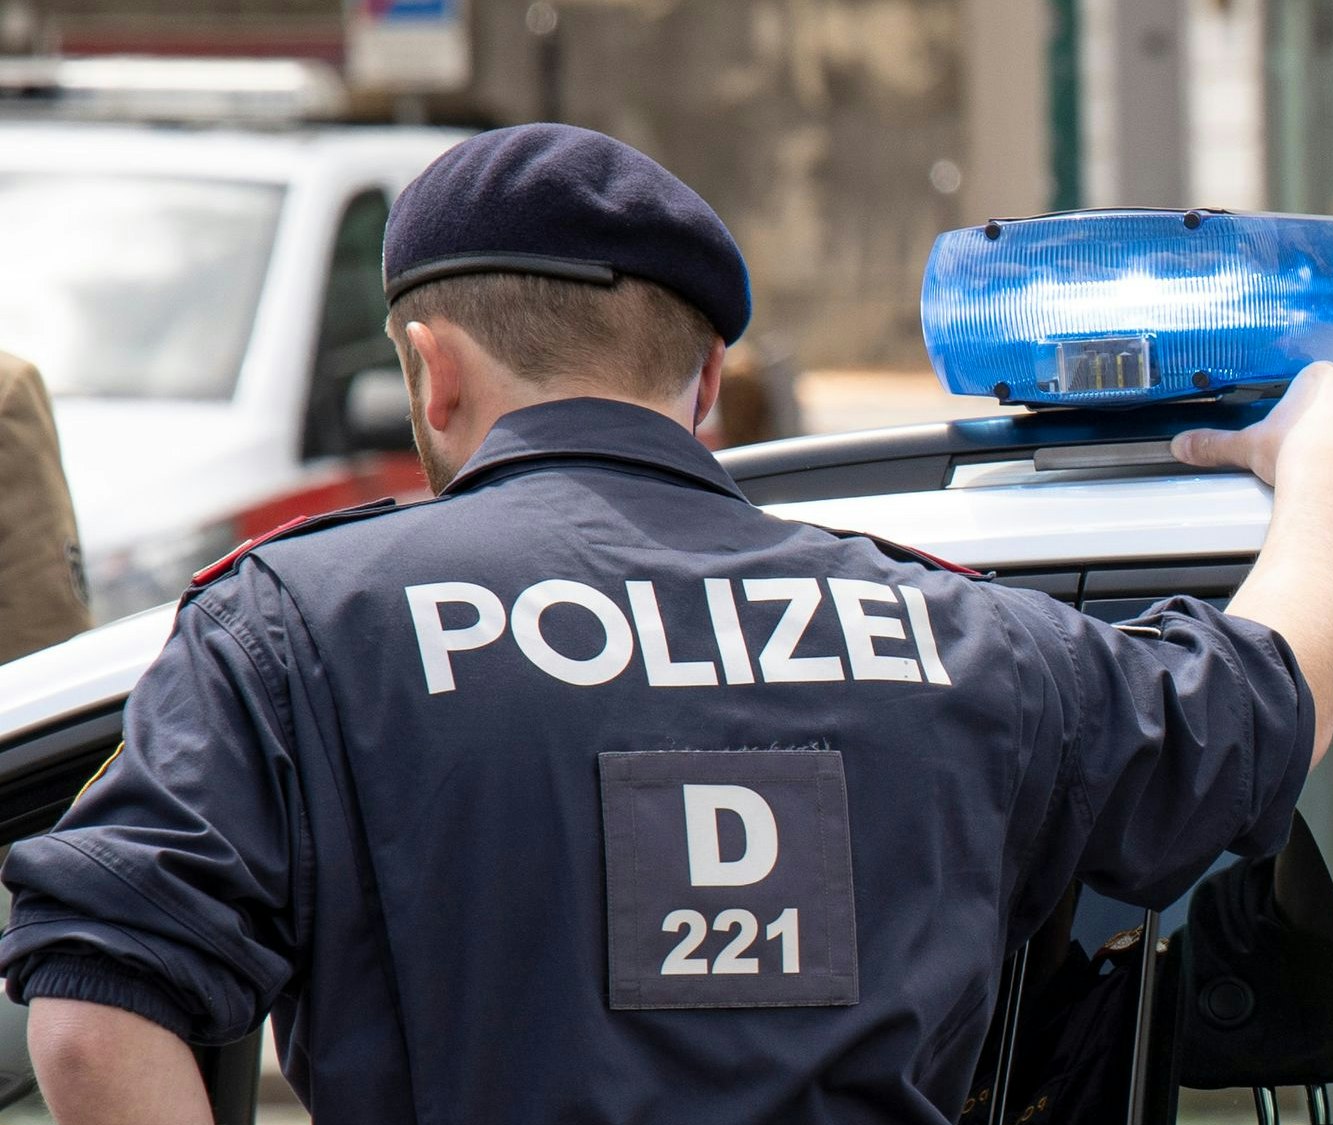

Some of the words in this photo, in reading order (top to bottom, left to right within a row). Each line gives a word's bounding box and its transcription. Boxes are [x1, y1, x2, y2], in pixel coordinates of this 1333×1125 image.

[405, 577, 952, 695] POLIZEI
[682, 784, 779, 887] D
[660, 907, 800, 975] 221
